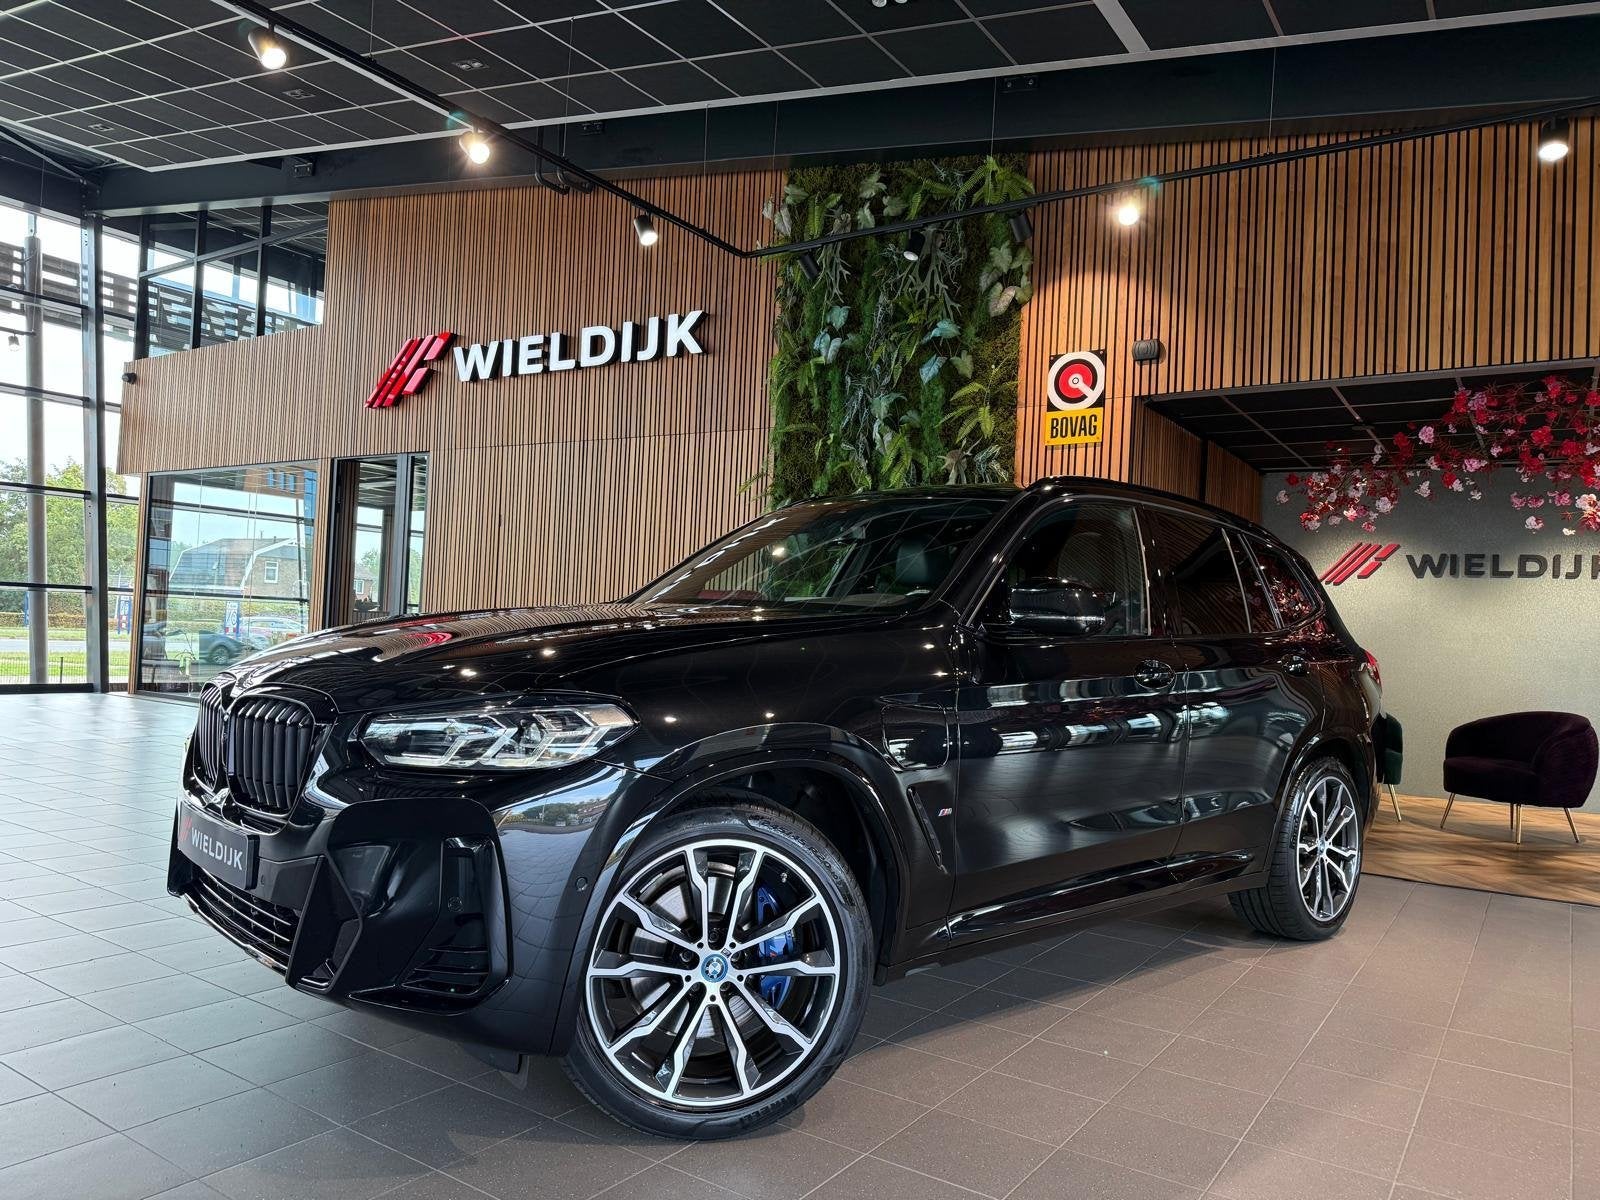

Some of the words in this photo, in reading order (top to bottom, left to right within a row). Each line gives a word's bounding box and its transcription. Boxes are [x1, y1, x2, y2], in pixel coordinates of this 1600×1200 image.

[453, 310, 707, 383] WIELDIJK
[1050, 414, 1098, 439] BOVAG
[191, 828, 242, 870] WIELDIJK
